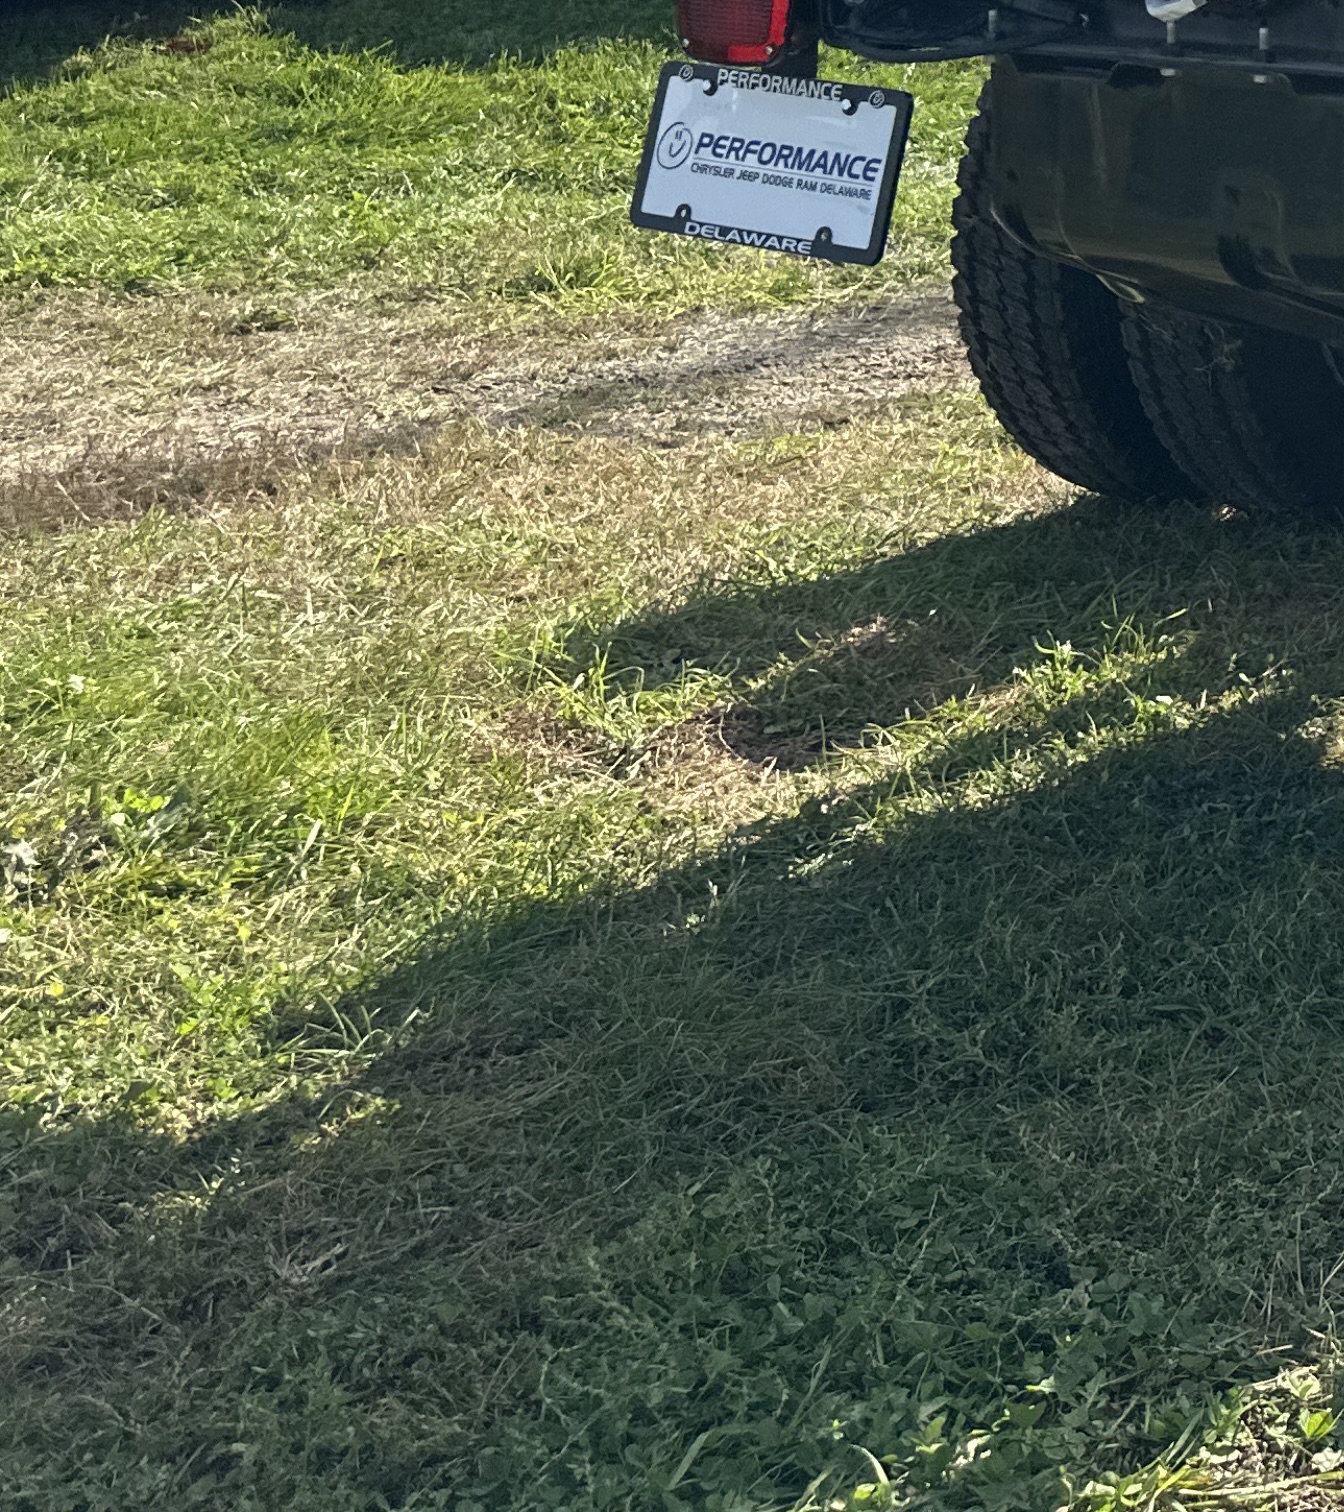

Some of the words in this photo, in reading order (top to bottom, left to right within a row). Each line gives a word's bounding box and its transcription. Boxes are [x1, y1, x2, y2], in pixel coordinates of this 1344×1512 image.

[717, 68, 843, 101] PERFORMANCE
[694, 132, 882, 182] PERFORMANCE
[690, 162, 735, 180] CHRYSLER
[736, 169, 760, 183] JEEP
[761, 173, 794, 188] DODGE
[795, 178, 818, 193] RAM
[819, 182, 873, 201] DELAWARE
[684, 221, 813, 255] DELAWARE
